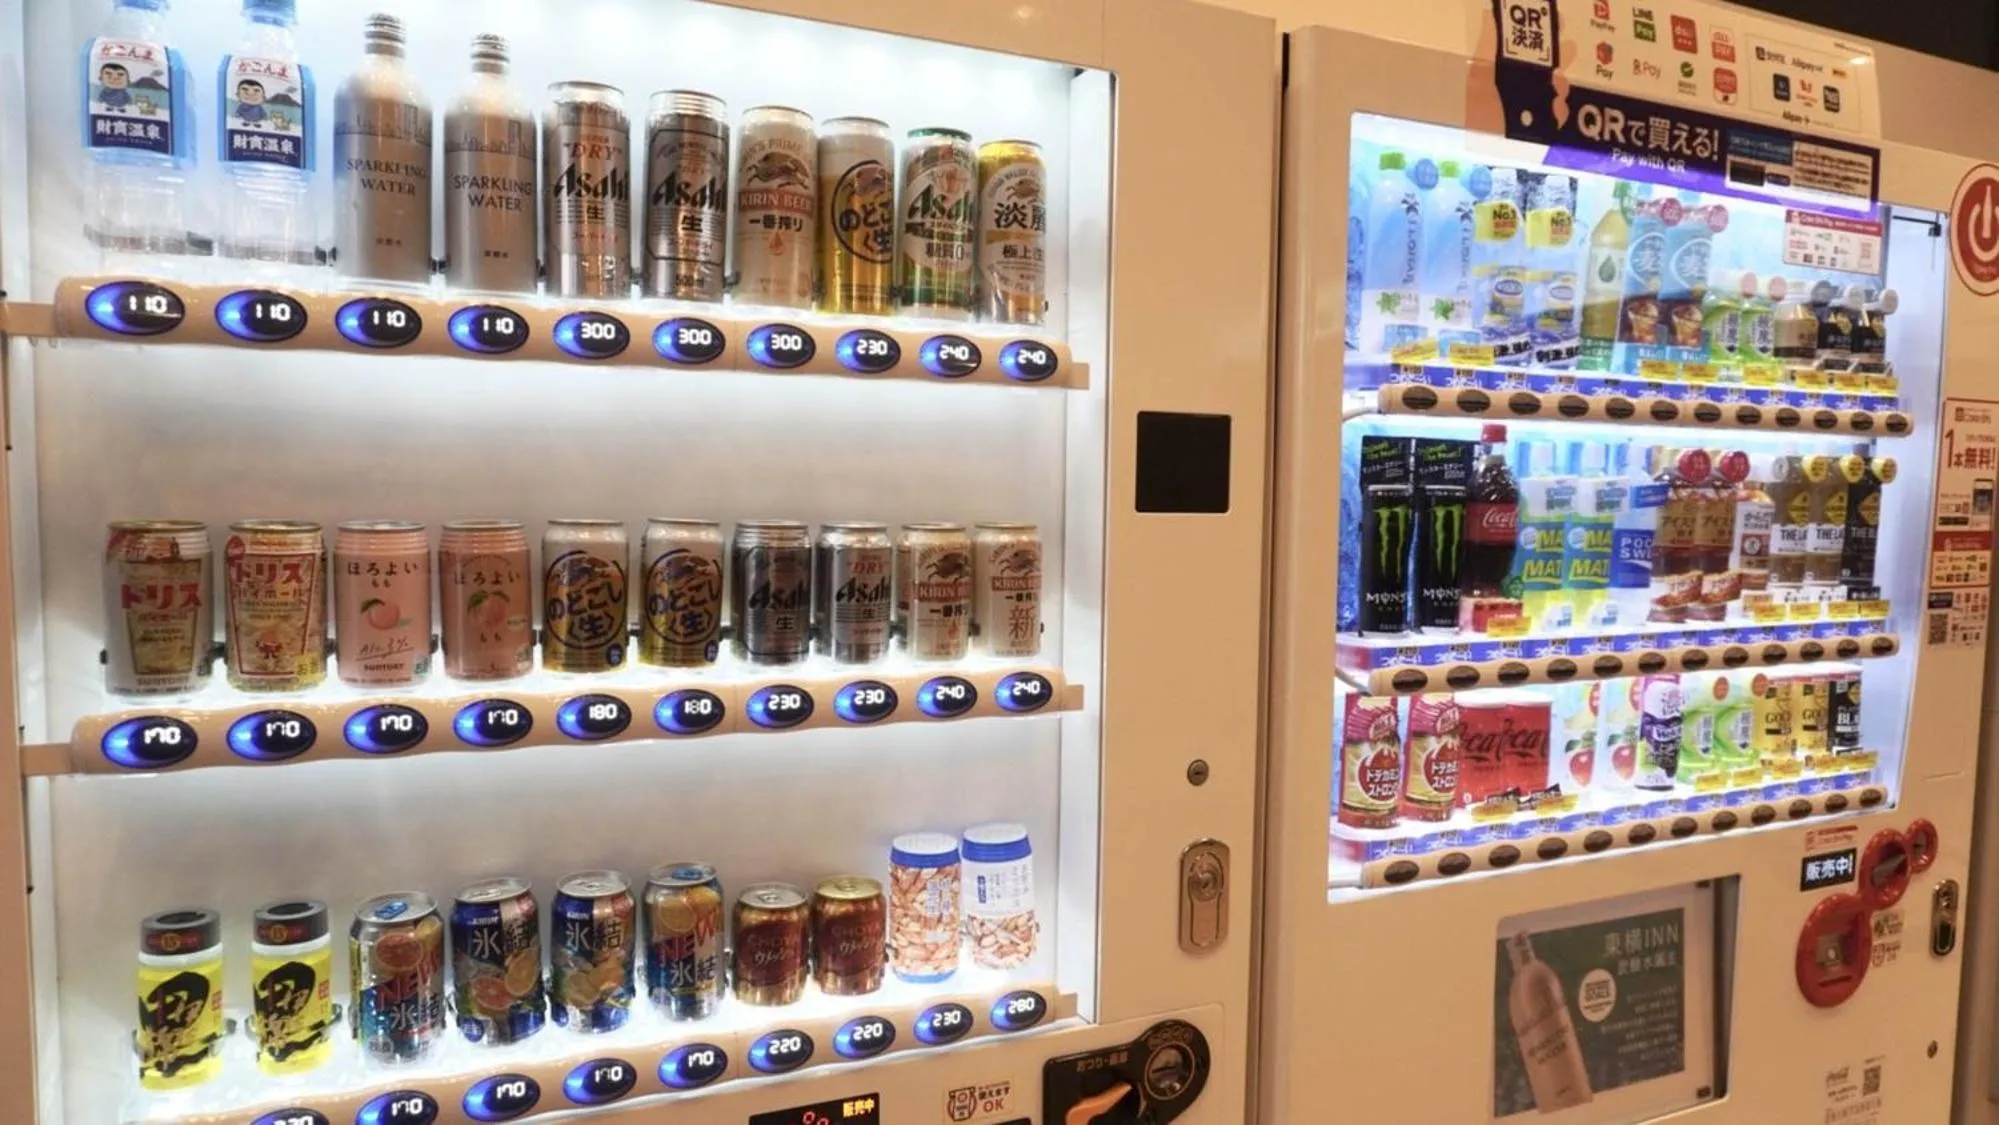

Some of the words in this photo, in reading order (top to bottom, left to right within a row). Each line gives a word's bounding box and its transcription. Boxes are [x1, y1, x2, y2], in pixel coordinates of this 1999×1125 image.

[1509, 5, 1541, 29] QR
[1632, 7, 1654, 21] LINE
[1511, 26, 1544, 51] 決済
[347, 158, 426, 179] SPARKLING
[1612, 148, 1634, 168] Pay
[1638, 152, 1664, 169] with
[1667, 157, 1686, 173] QR
[360, 178, 416, 197] WATER
[452, 174, 532, 196] SPARKLING
[468, 194, 522, 212] WATER
[741, 193, 780, 208] KIRIN
[586, 204, 605, 220] 生
[681, 216, 703, 233] 生
[749, 214, 803, 232] 一番搾り
[128, 295, 167, 314] 110
[255, 302, 292, 322] 110
[373, 310, 406, 328] 110
[483, 317, 515, 336] 110
[581, 321, 616, 341] 300
[677, 327, 713, 346] 300
[770, 333, 802, 352] 300
[856, 338, 889, 357] 230
[939, 344, 970, 362] 240
[1017, 348, 1047, 366] 240
[1780, 529, 1797, 541] THE
[1816, 528, 1834, 540] THE
[235, 563, 304, 583] トリス
[348, 562, 418, 577] ほろよい
[454, 571, 520, 586] ほろよい
[371, 578, 391, 589] もも
[920, 585, 956, 598] KIRIN
[121, 583, 202, 610] トリス
[776, 616, 793, 630] 生
[1008, 605, 1036, 639] 新
[935, 684, 966, 700] 240
[1012, 680, 1041, 695] 240
[768, 694, 800, 710] 230
[854, 689, 885, 705] 230
[588, 703, 617, 720] 180
[684, 698, 712, 715] 180
[380, 714, 413, 732] 170
[487, 709, 519, 726] 170
[143, 726, 182, 745] 170
[265, 720, 301, 738] 170
[565, 918, 622, 951] 氷結
[655, 911, 716, 968] NEW
[1602, 923, 1679, 957] 東横INN
[670, 955, 717, 986] 氷結
[1008, 998, 1036, 1014] 280
[933, 1011, 961, 1027] 230
[854, 1024, 883, 1041] 220
[769, 1037, 801, 1055] 220
[688, 1051, 715, 1067] 170
[594, 1066, 623, 1082] 170
[497, 1082, 526, 1098] 170
[392, 1099, 422, 1115] 170
[843, 1098, 875, 1118] 販売中
[983, 1098, 1004, 1113] OK
